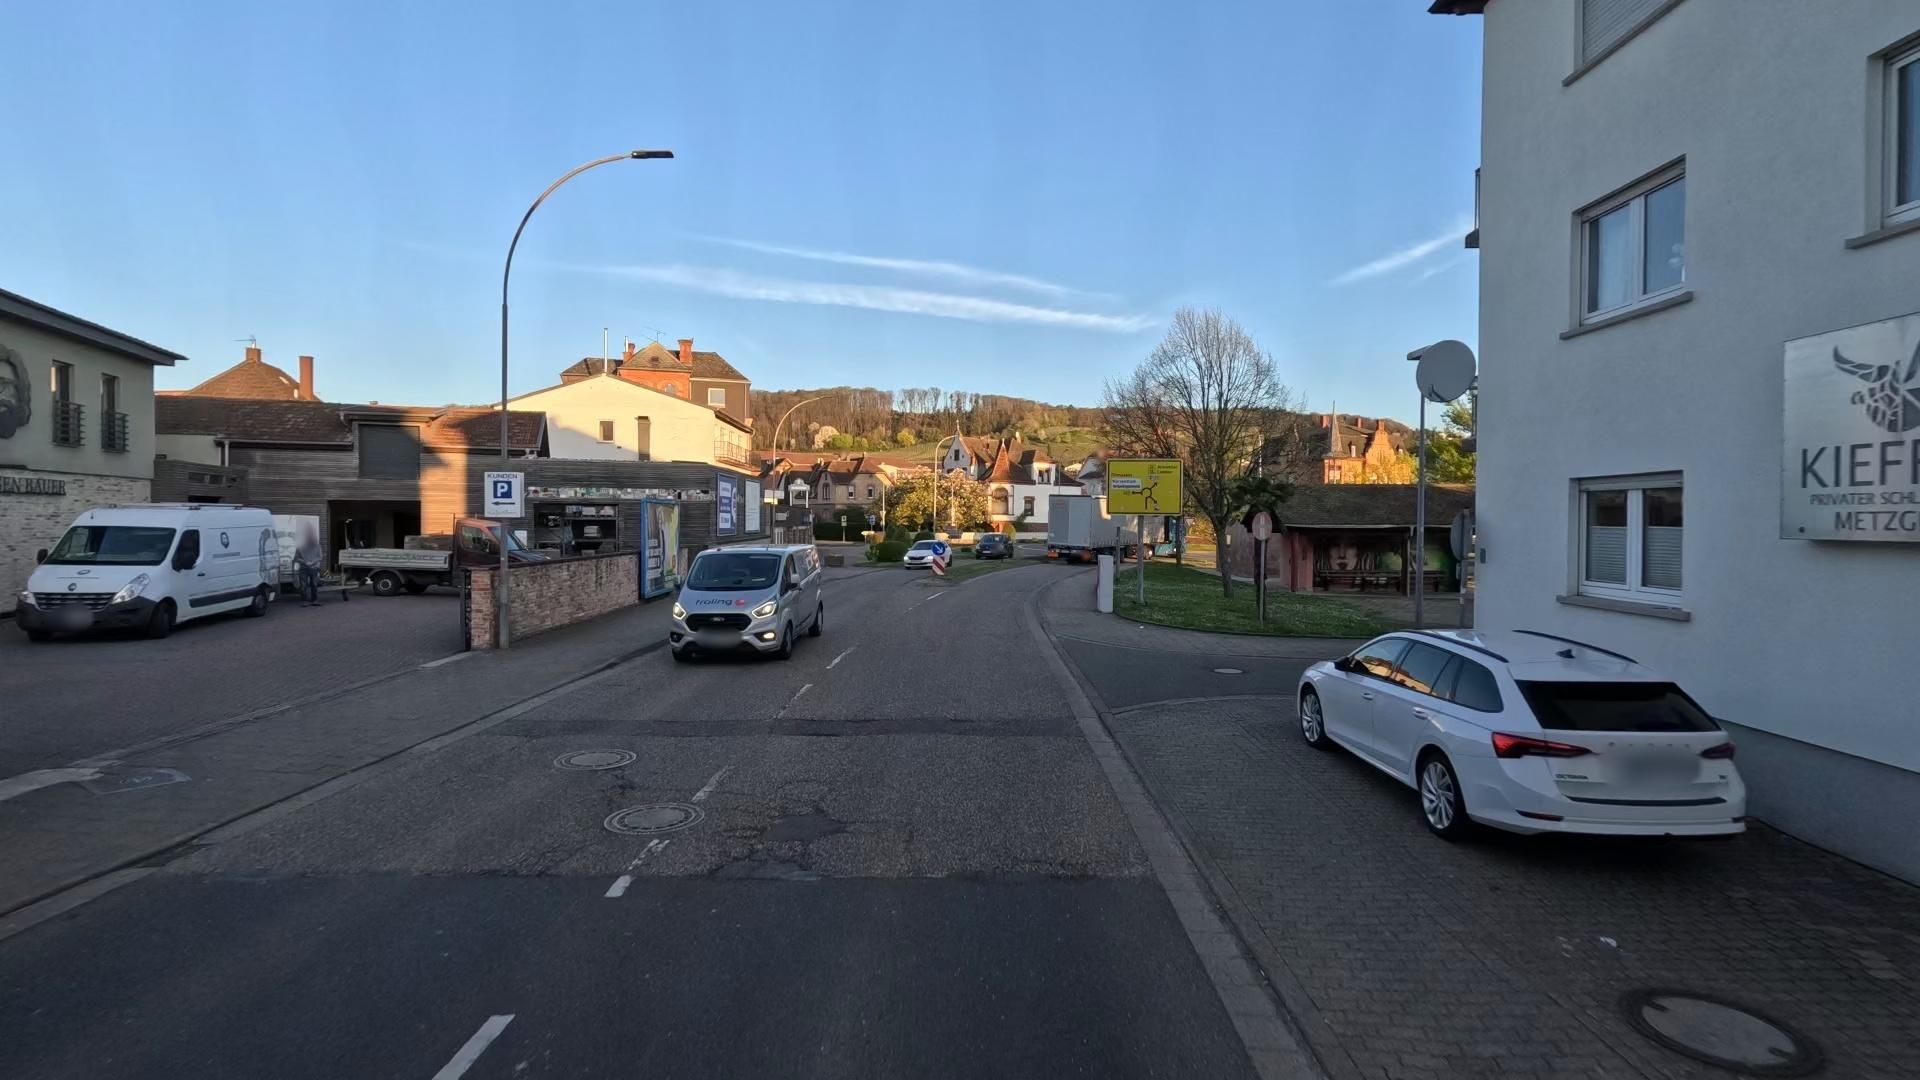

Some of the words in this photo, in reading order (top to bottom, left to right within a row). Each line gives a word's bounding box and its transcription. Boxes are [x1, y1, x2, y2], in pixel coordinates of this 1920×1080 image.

[497, 482, 508, 497] P
[1810, 492, 1876, 505] PRIVATER
[1834, 510, 1920, 532] METZG
